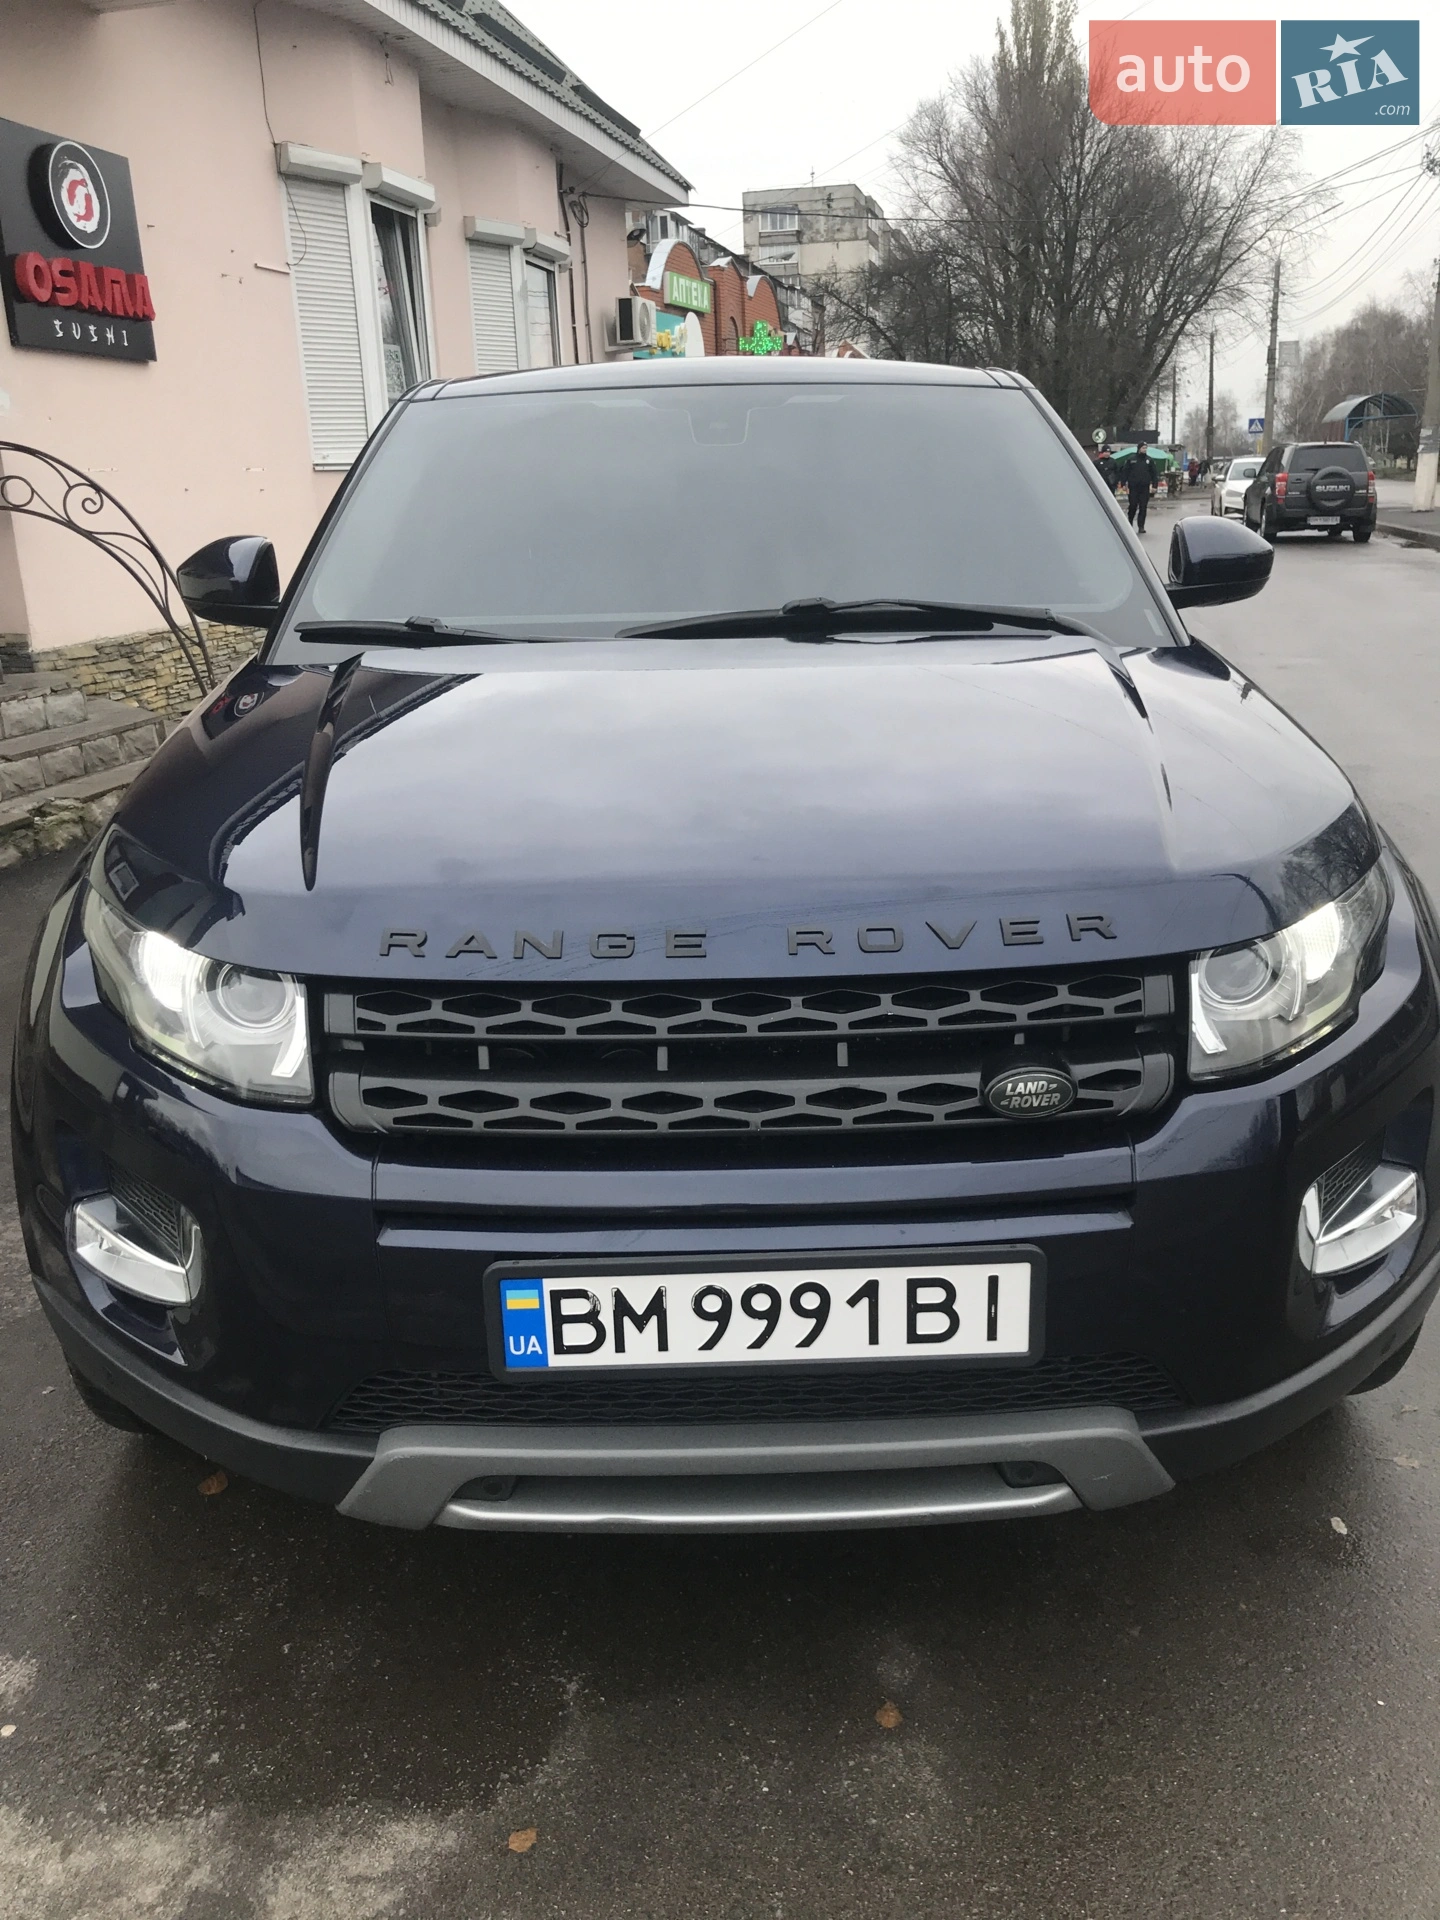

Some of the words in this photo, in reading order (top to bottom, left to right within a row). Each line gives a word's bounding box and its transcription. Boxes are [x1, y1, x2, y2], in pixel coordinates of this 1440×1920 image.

[15, 251, 156, 321] OSAMA
[672, 275, 709, 310] АПТЕКА
[53, 319, 128, 346] SUSHI
[1315, 484, 1351, 492] SUZUKI
[379, 927, 707, 959] RANGE
[786, 912, 1117, 956] ROVER
[1005, 1080, 1048, 1096] LAND
[1009, 1093, 1061, 1109] ROVER
[549, 1285, 669, 1355] BM
[690, 1278, 880, 1351] 9991
[508, 1335, 543, 1356] UA
